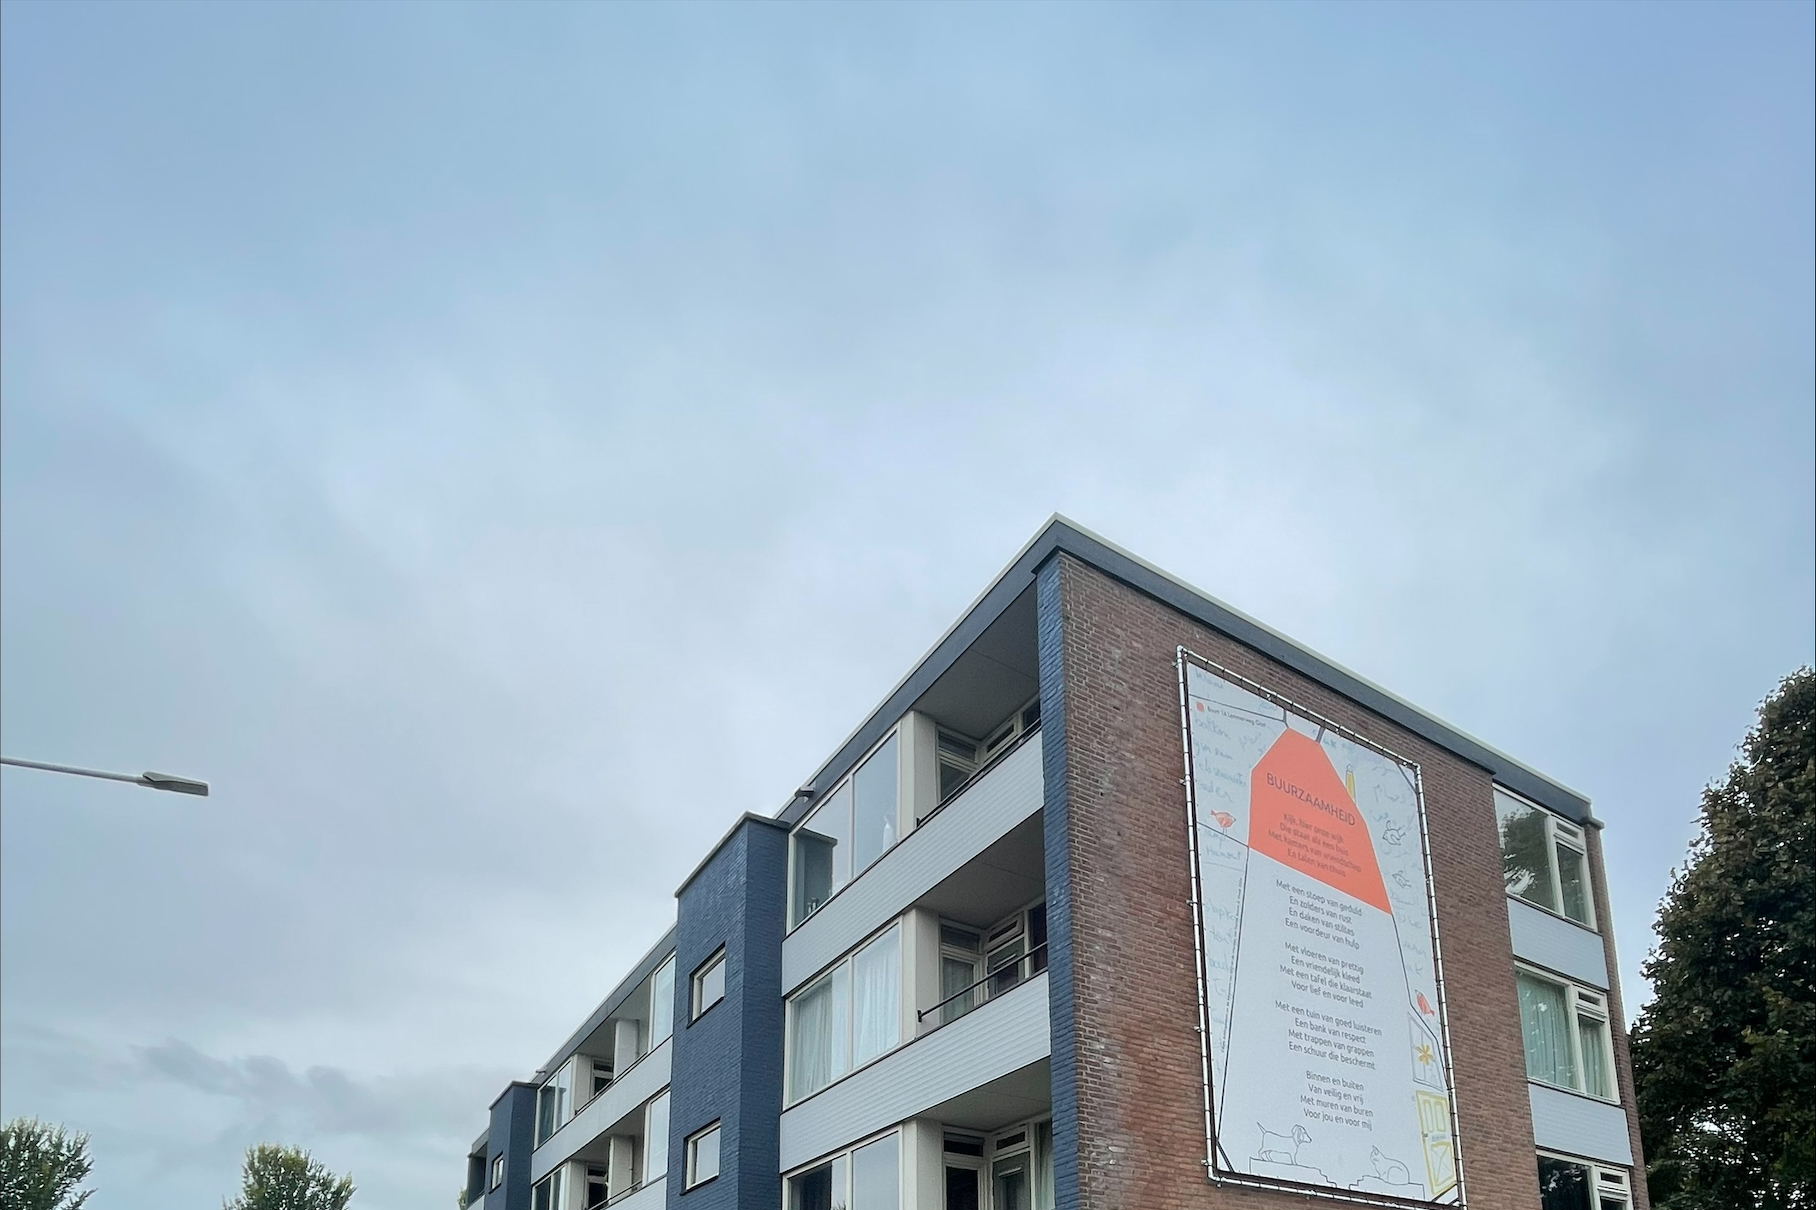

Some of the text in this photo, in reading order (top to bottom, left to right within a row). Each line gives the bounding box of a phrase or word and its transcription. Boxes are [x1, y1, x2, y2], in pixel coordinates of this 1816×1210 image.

[1267, 772, 1355, 825] BUURZAAMHEID
[1280, 822, 1291, 834] Die
[1268, 830, 1282, 842] Met
[1310, 848, 1321, 858] van
[1287, 848, 1296, 858] En
[1317, 861, 1328, 871] van
[1276, 879, 1362, 916] Met een stoep van geduld
[1290, 896, 1298, 906] En
[1300, 900, 1324, 915] zolders
[1326, 910, 1337, 918] van
[1289, 907, 1298, 917] En
[1299, 911, 1320, 924] daken
[1321, 919, 1333, 929] van
[1285, 918, 1360, 950] Een voordeur van hulp
[1285, 942, 1364, 975] Met vloeren van prettig
[1291, 956, 1360, 984] Een vriendelijk kleed
[1280, 965, 1372, 999] Met een tafel die klaarstaat
[1291, 980, 1308, 991] Voor
[1310, 984, 1321, 995] lief
[1333, 994, 1348, 1003] voor
[1349, 996, 1363, 1008] leed
[1275, 1000, 1382, 1036] Met een tuin van goed luisteren
[1295, 1018, 1366, 1044] Een bank van respect
[1289, 1029, 1374, 1057] Met trappen van grappen
[1289, 1041, 1376, 1070] Een schuur die beschermt
[1306, 1070, 1364, 1091] Binnen en buiten
[1308, 1083, 1364, 1105] Van veilig en vrij
[1300, 1095, 1373, 1117] Met muren van buren
[1303, 1108, 1321, 1119] Voor
[1322, 1111, 1333, 1122] jou
[1345, 1118, 1360, 1127] voor
[1361, 1120, 1372, 1131] mij
